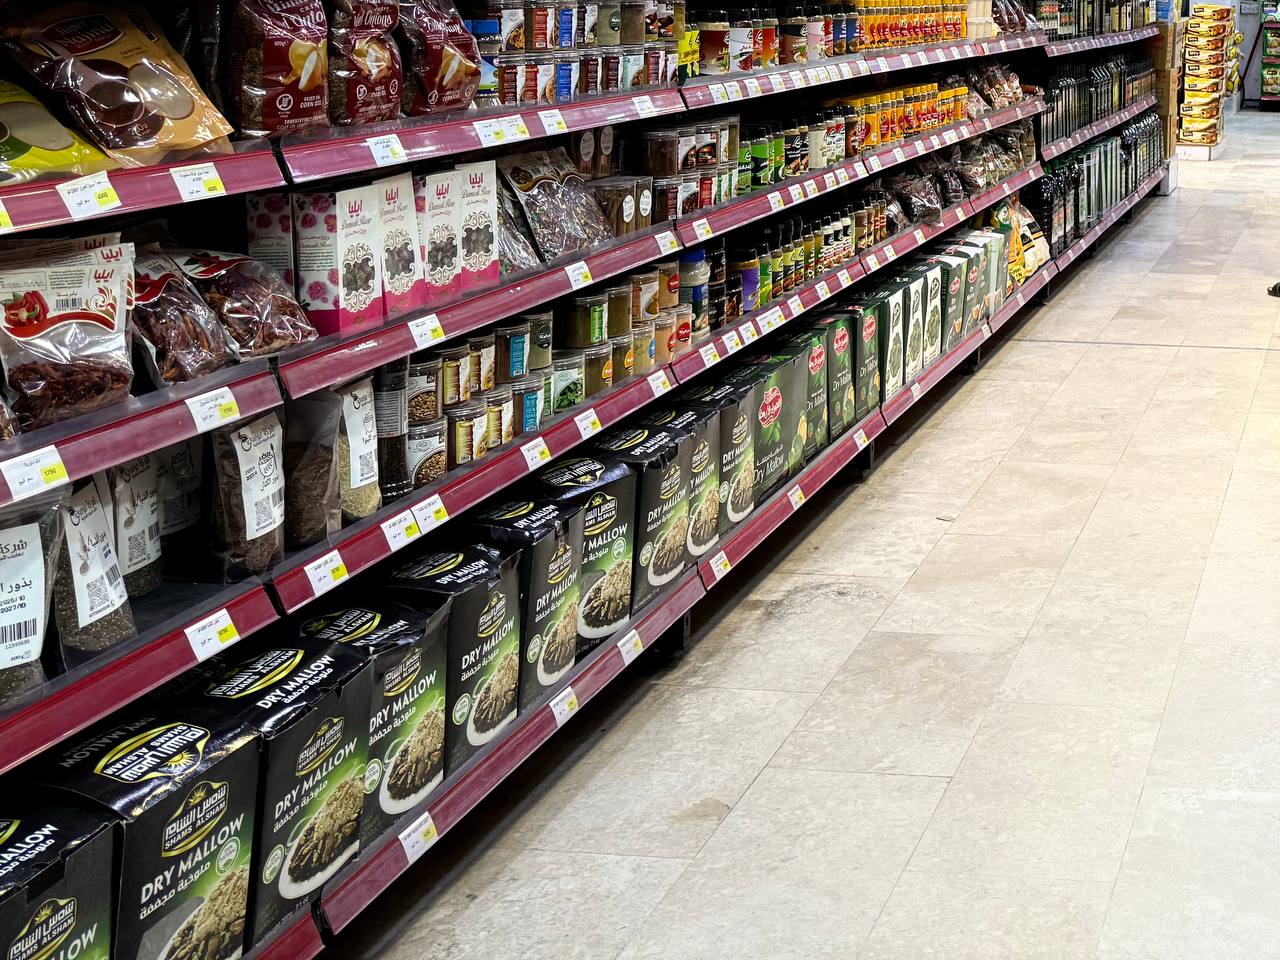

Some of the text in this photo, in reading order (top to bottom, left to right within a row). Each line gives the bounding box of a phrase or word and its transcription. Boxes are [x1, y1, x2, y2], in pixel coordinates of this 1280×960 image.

[587, 523, 628, 551] MALLOW
[536, 569, 578, 612] DRY MALLOW
[461, 616, 515, 669] DRY MALLOW
[226, 674, 260, 696] SHAMS
[256, 654, 336, 710] DRY MALLOW
[369, 670, 437, 733] DRY MALLOW
[275, 737, 358, 820] DRY MALLOW
[164, 800, 226, 851] SHAMS ALSHAM
[141, 864, 176, 905] DRY
[178, 812, 245, 877] MALLOW
[42, 917, 74, 944] ALSHAM
